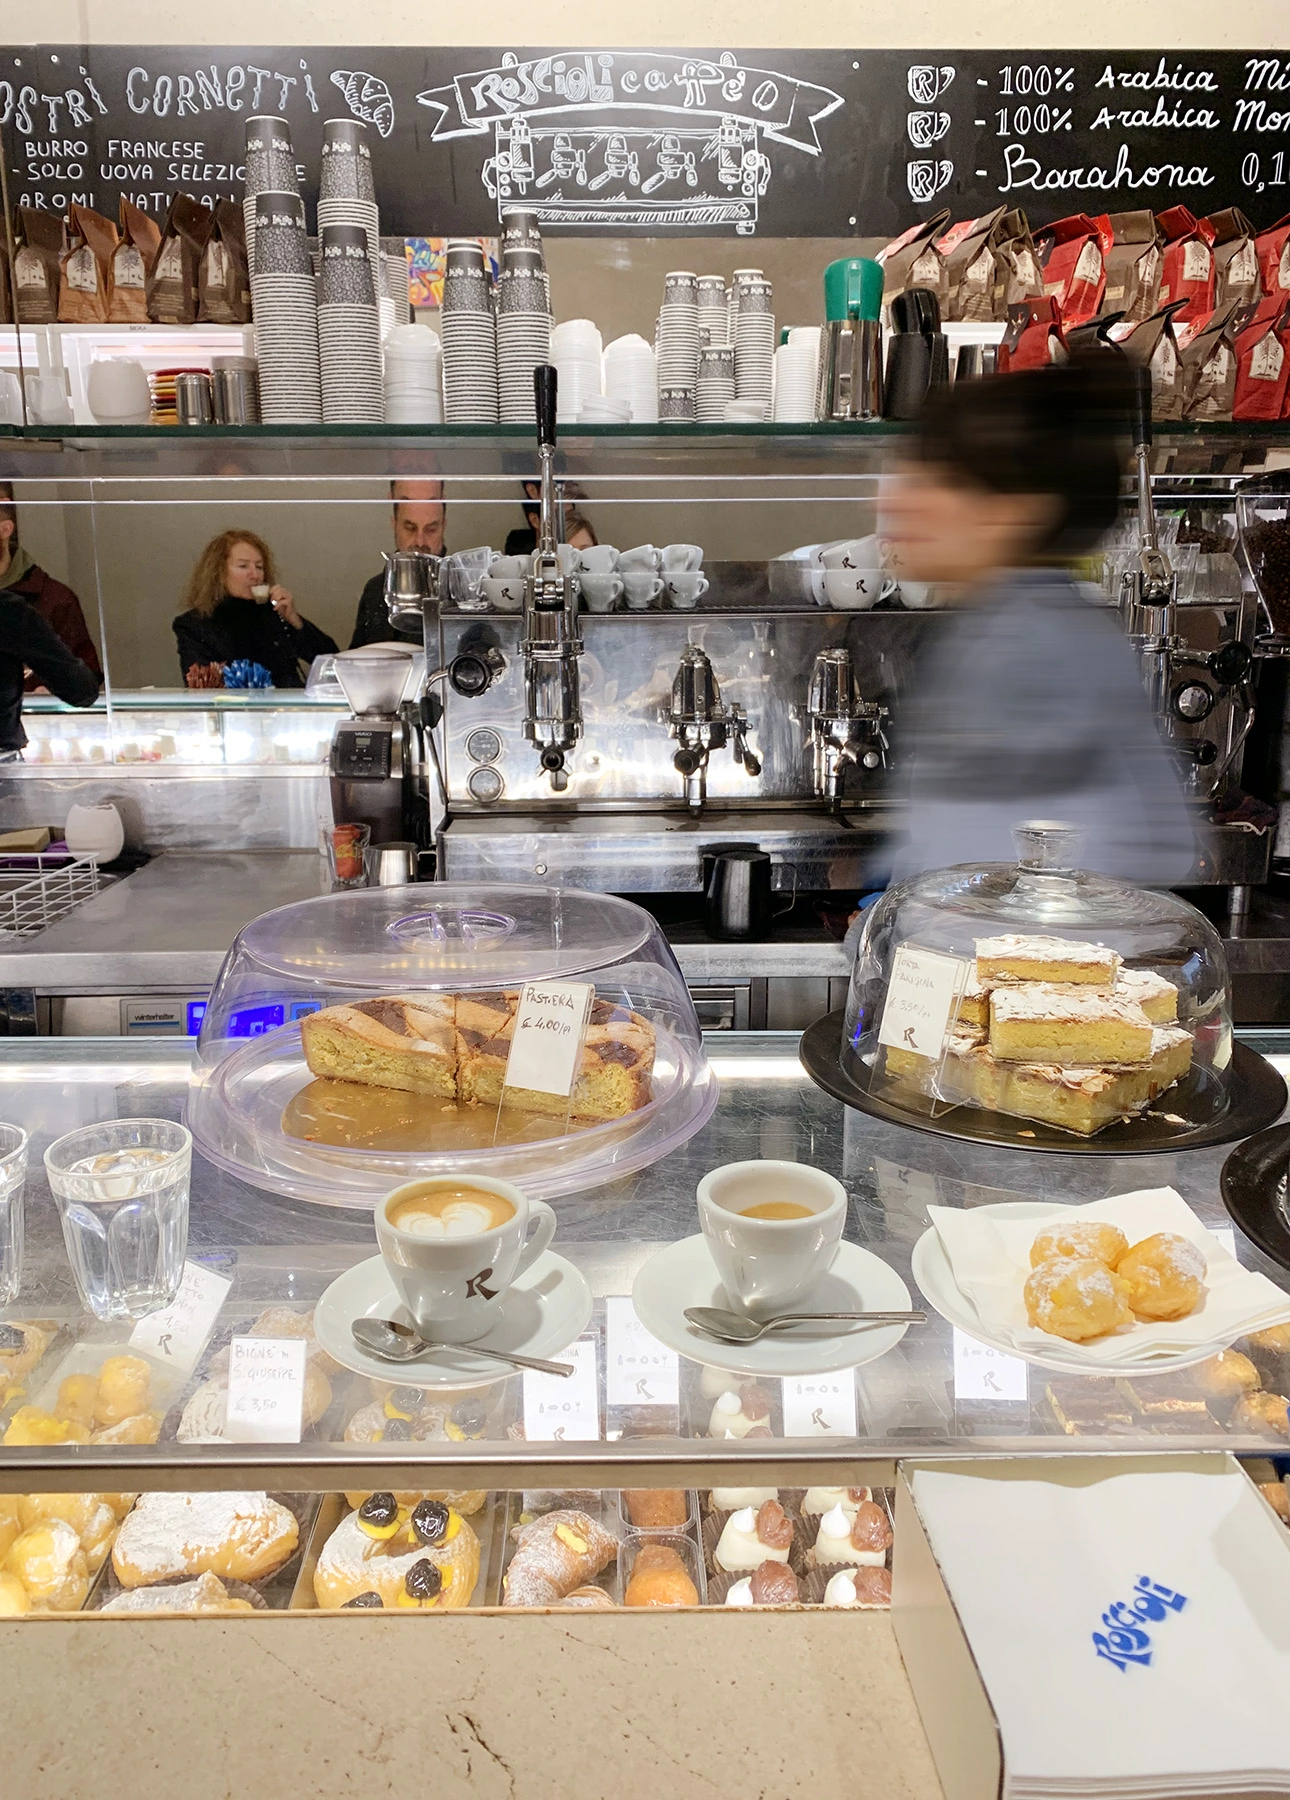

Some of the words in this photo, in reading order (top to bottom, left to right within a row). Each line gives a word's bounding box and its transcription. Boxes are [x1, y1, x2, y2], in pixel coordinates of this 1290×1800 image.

[998, 65, 1075, 96] 100%
[1095, 57, 1218, 92] Arabica
[995, 103, 1073, 136] 100%
[1089, 96, 1220, 129] Arabica
[25, 140, 88, 158] BURRO
[108, 140, 205, 160] FRANCESE
[27, 163, 83, 180] SOLO
[101, 164, 153, 181] UOVA
[998, 144, 1215, 192] Barahona
[20, 192, 94, 209] AROMI
[902, 1026, 919, 1049] R
[465, 1267, 500, 1301] R
[157, 1333, 173, 1356] R
[635, 1377, 657, 1400] R
[982, 1370, 1004, 1393] R
[811, 1407, 832, 1430] R
